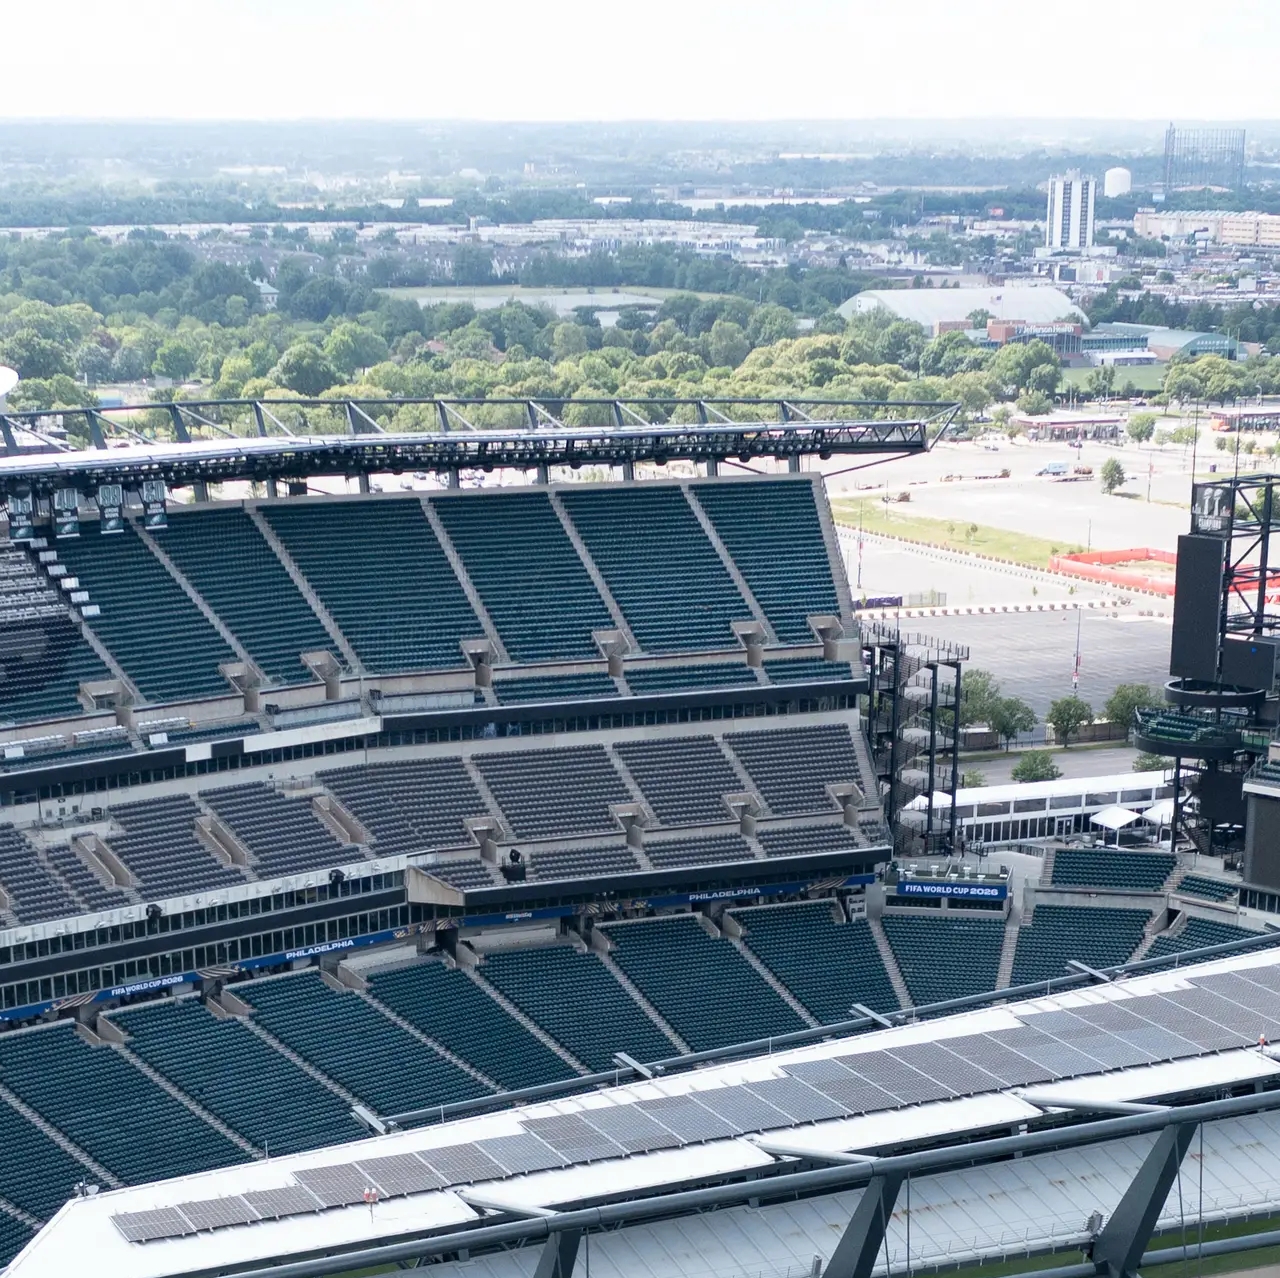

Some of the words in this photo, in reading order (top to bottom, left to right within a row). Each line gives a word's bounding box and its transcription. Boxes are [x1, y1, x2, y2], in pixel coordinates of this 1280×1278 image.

[56, 488, 78, 510] 40
[100, 485, 122, 507] 99
[689, 887, 761, 901] PHILADELPHIA
[905, 884, 923, 893] FIFA
[922, 885, 952, 894] WORLD
[952, 886, 970, 894] CUP
[969, 887, 999, 896] 2026
[286, 939, 355, 960] PHILADELPHIA
[111, 987, 126, 997] FIFA
[125, 981, 149, 996] WORLD
[148, 979, 162, 989] CUP
[161, 975, 184, 986] 2026
